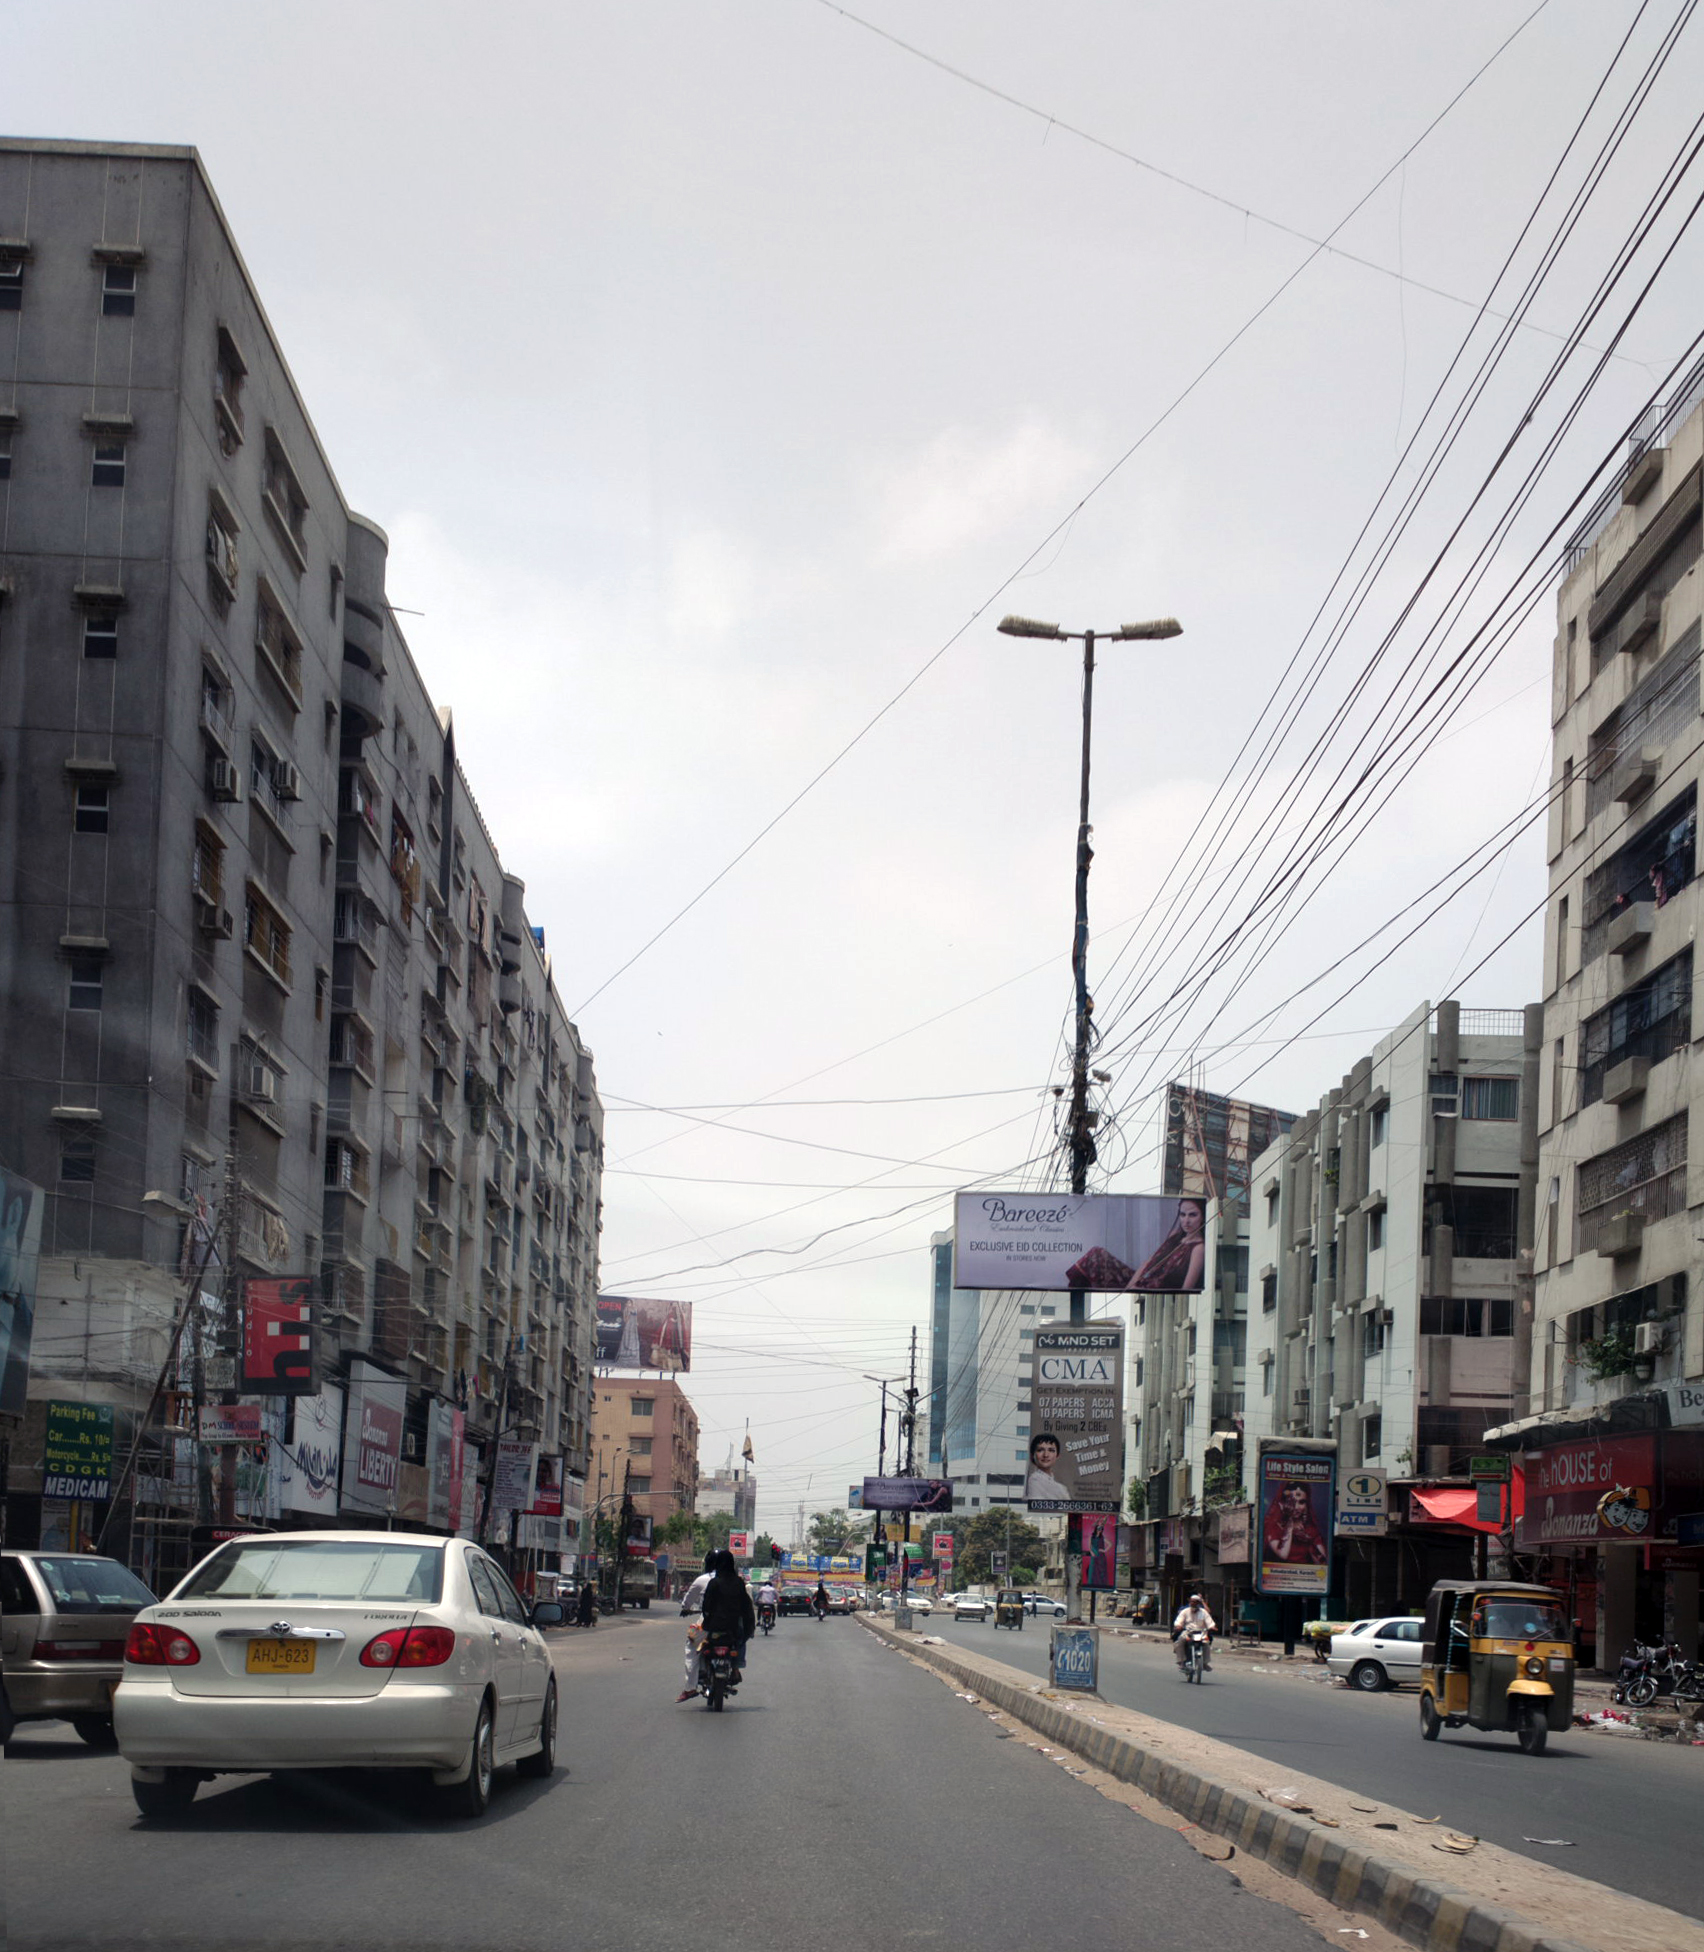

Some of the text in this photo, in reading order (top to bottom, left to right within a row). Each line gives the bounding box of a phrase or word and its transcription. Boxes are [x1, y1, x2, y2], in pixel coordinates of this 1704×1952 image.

[969, 1241, 1083, 1253] EXCLUSIVE EID COLLECTION
[1041, 1358, 1110, 1380] CMA
[1039, 1397, 1115, 1408] 07 PAPERS ACCA
[50, 1404, 96, 1422] Parking Fee
[1040, 1408, 1051, 1418] 10
[1052, 1408, 1085, 1419] PAPERS
[1043, 1421, 1053, 1432] By
[1055, 1421, 1078, 1433] Giving
[1080, 1421, 1086, 1431] 2
[1065, 1433, 1110, 1452] Save Your
[1074, 1450, 1099, 1463] Time
[360, 1444, 399, 1488] LIBERTY
[1078, 1461, 1110, 1476] Money
[1266, 1461, 1329, 1475] Life Style Salon
[1600, 1457, 1613, 1482] of
[44, 1476, 109, 1499] MEDICAM
[1355, 1478, 1369, 1494] 1
[1341, 1515, 1369, 1523] ATM
[1541, 1496, 1598, 1539] Bonanza
[251, 1648, 310, 1664] AHJ-623
